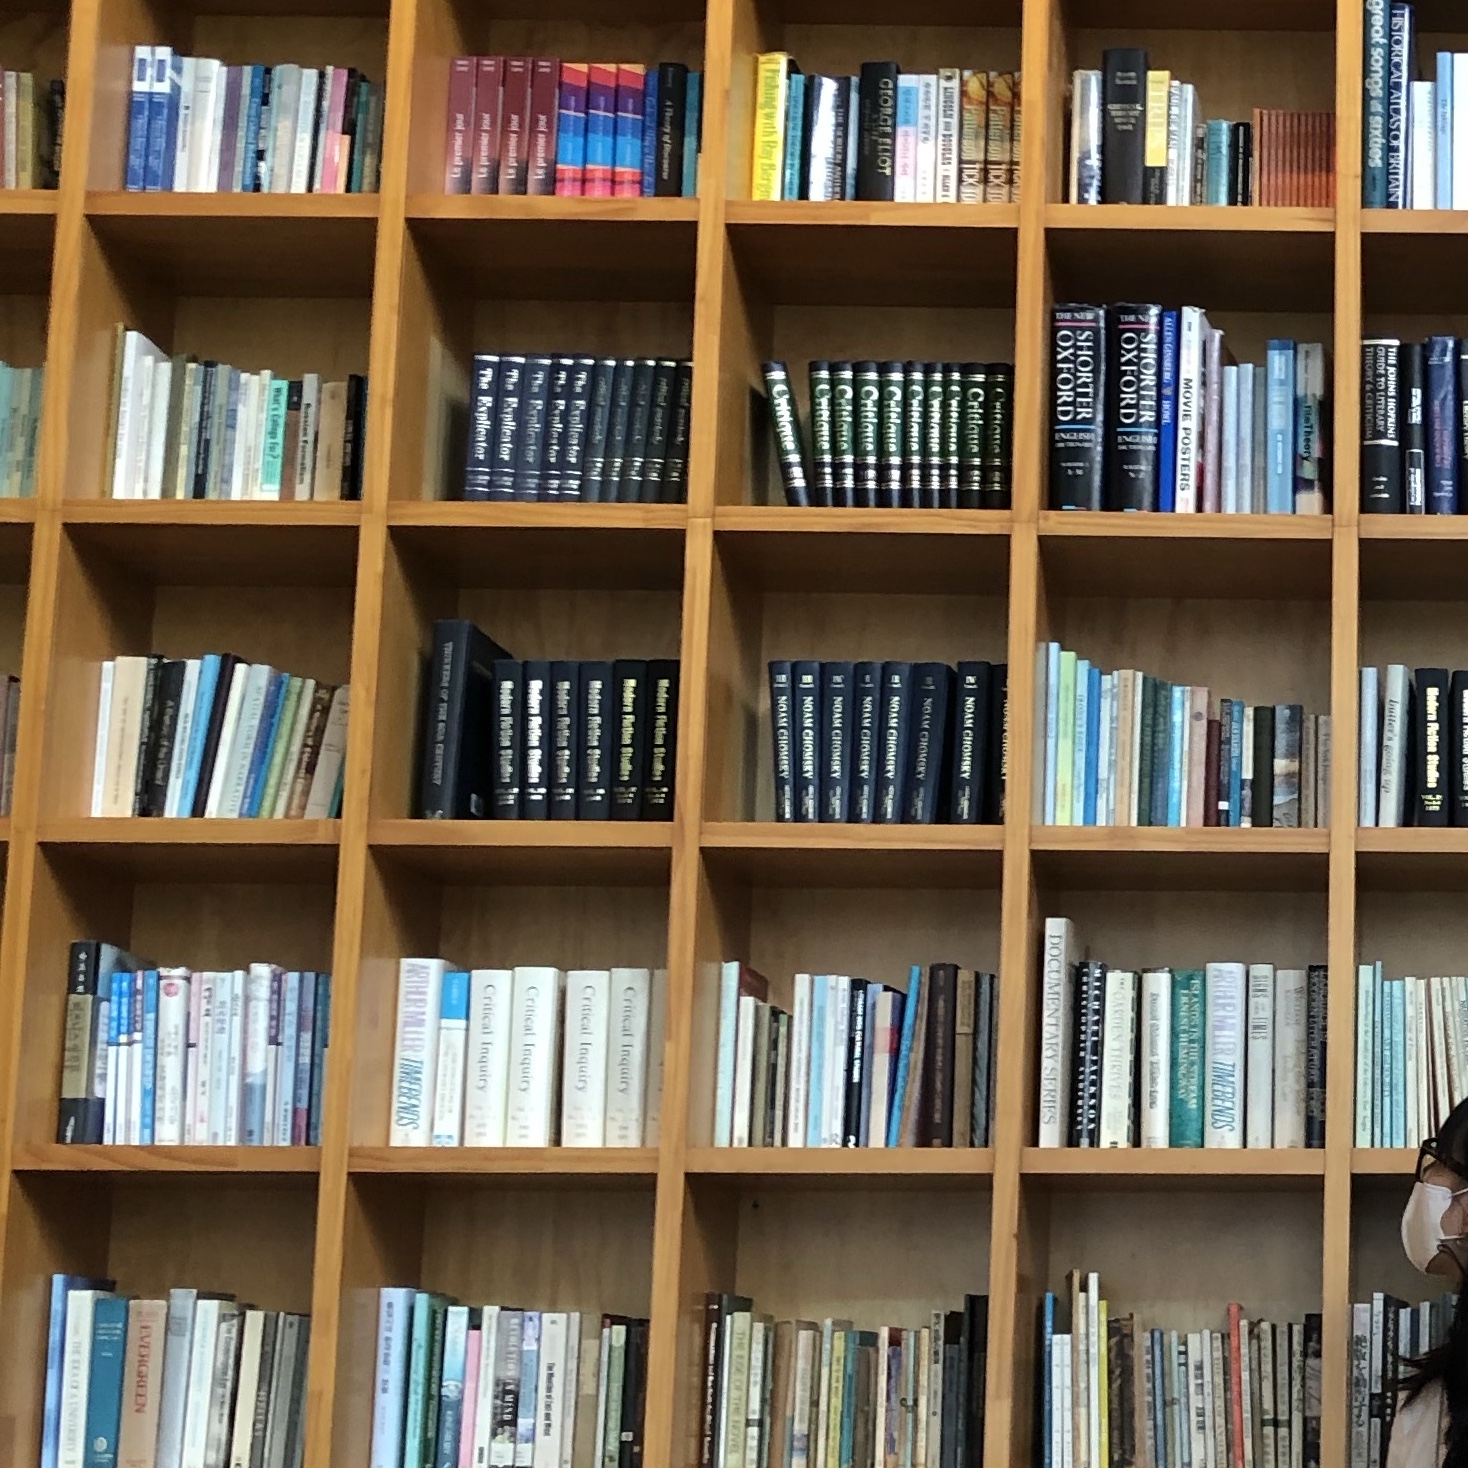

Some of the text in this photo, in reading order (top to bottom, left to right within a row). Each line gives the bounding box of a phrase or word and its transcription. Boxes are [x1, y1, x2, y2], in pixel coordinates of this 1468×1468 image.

[759, 68, 781, 161] Fishing with Ray
[878, 78, 892, 176] GEORGE ELIOT
[941, 87, 954, 166] LINCOLN DOUGLAS
[989, 106, 1008, 186] Patterson TICK
[1389, 90, 1404, 128] ATLAS
[1389, 131, 1400, 148] OF
[1387, 152, 1400, 202] BRITAIN
[1056, 330, 1074, 421] OXFORD
[1076, 331, 1093, 420] SHORTER
[1119, 332, 1137, 424] OXFORD
[1139, 332, 1156, 422] SHORTER
[1365, 347, 1374, 381] THEORY
[1376, 347, 1385, 432] GUIDE TO LITERARY
[1386, 347, 1396, 438] THE JOHNS HOPKINS
[298, 403, 311, 484] Russian Formalism
[475, 368, 493, 460] The Explicator
[772, 384, 798, 450] Critique
[835, 385, 853, 450] Critique
[860, 386, 878, 450] Critique
[1162, 401, 1171, 425] HOWL
[1179, 378, 1193, 491] MOVIE POSTERS
[1364, 393, 1372, 439] CRITICISM
[652, 679, 669, 780] Modern Fiction Studies
[777, 697, 788, 778] NOAM CHOMSKY
[801, 696, 813, 778] NOAM CHOMSKY
[1383, 745, 1396, 776] going
[1381, 779, 1391, 793] up
[396, 964, 430, 1129] ARTHUR MILLER TIMEBENDS
[519, 986, 539, 1093] Critical Inquiry
[576, 985, 595, 1092] Critical Inquiry
[1043, 935, 1062, 1124] DOCUMENTARY SERIES
[134, 1325, 152, 1413] EVERGREEN
[734, 1355, 745, 1376] RISE
[736, 1330, 745, 1351] THE
[729, 1420, 742, 1455] NOVEL
[732, 1397, 744, 1417] THE
